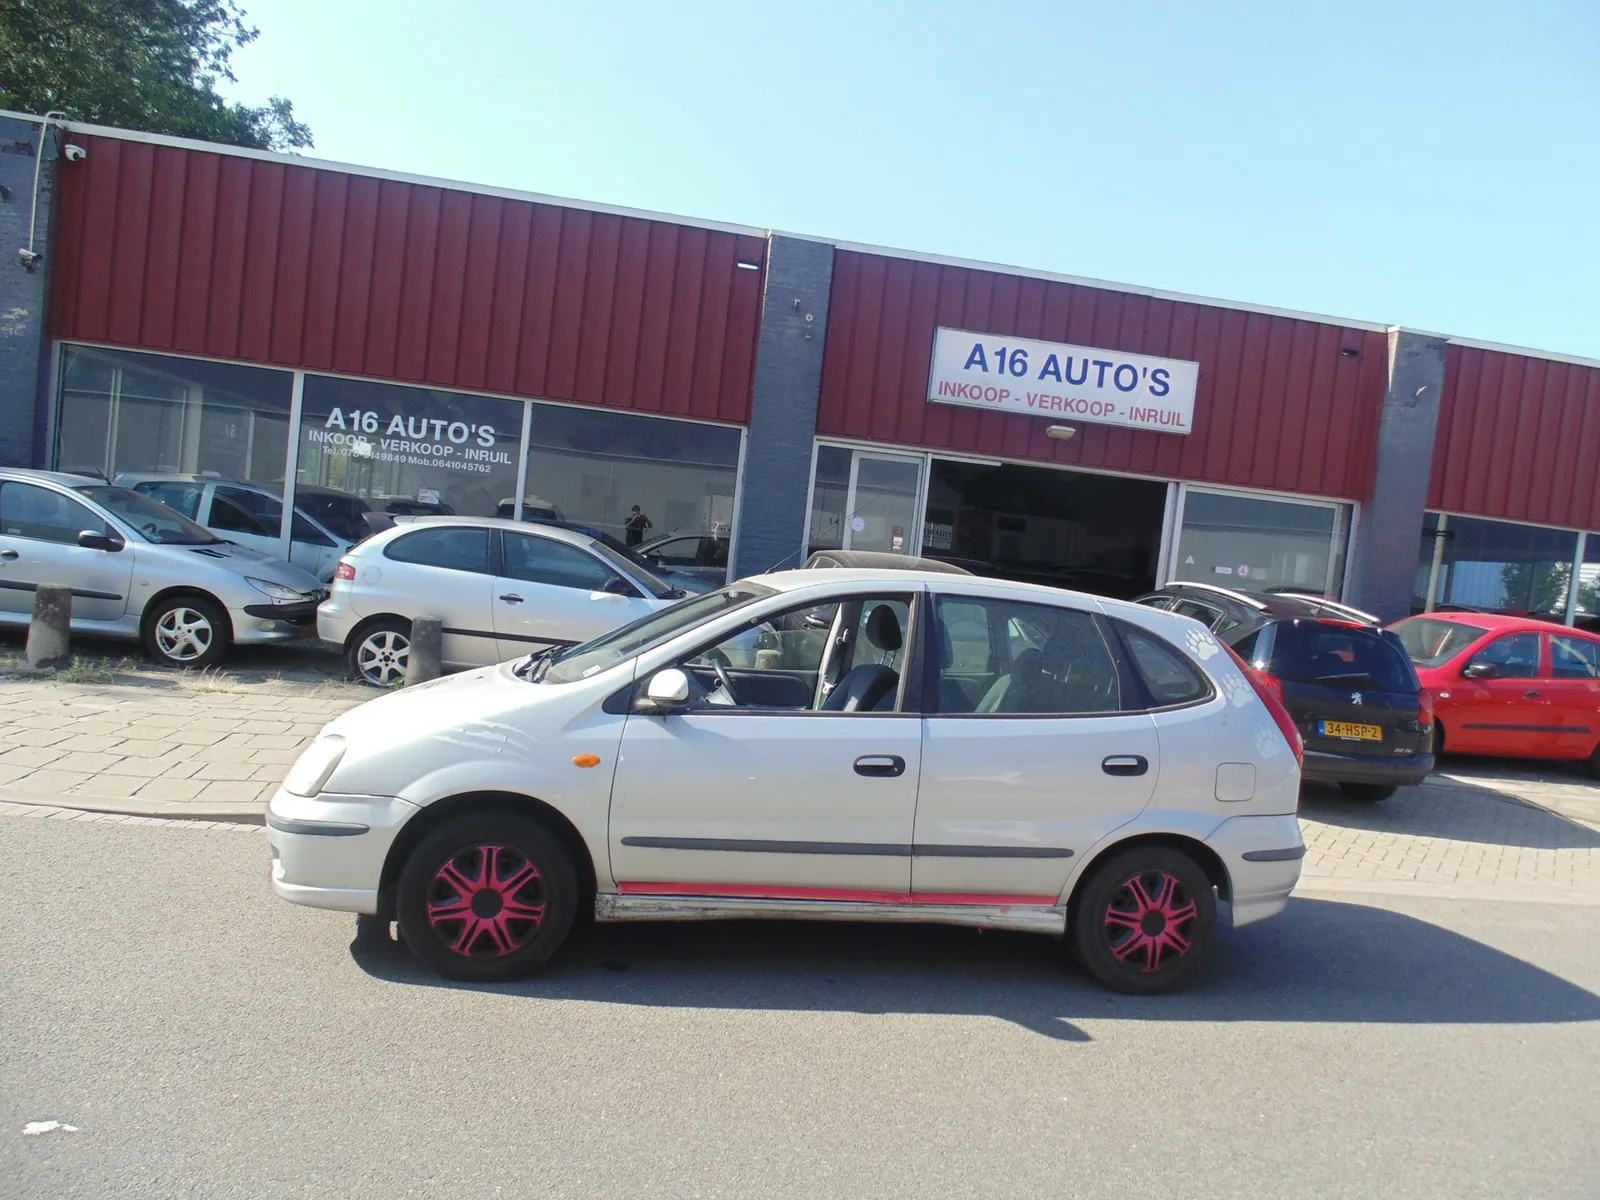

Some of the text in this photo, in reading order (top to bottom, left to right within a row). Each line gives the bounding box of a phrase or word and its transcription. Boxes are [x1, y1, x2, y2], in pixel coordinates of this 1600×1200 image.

[963, 343, 1171, 397] A16 AUTO'S
[938, 380, 1010, 404] INKOOP
[1026, 392, 1116, 418] VERKOOP
[1128, 406, 1186, 427] INRUIL
[325, 407, 496, 447] A16 AUTO'S
[322, 446, 339, 456] Tel.
[408, 456, 492, 473] Mob.0641045762
[380, 438, 454, 457] VERKOOP
[465, 448, 512, 464] INRUIL
[1328, 722, 1378, 738] 34-HSP-2
